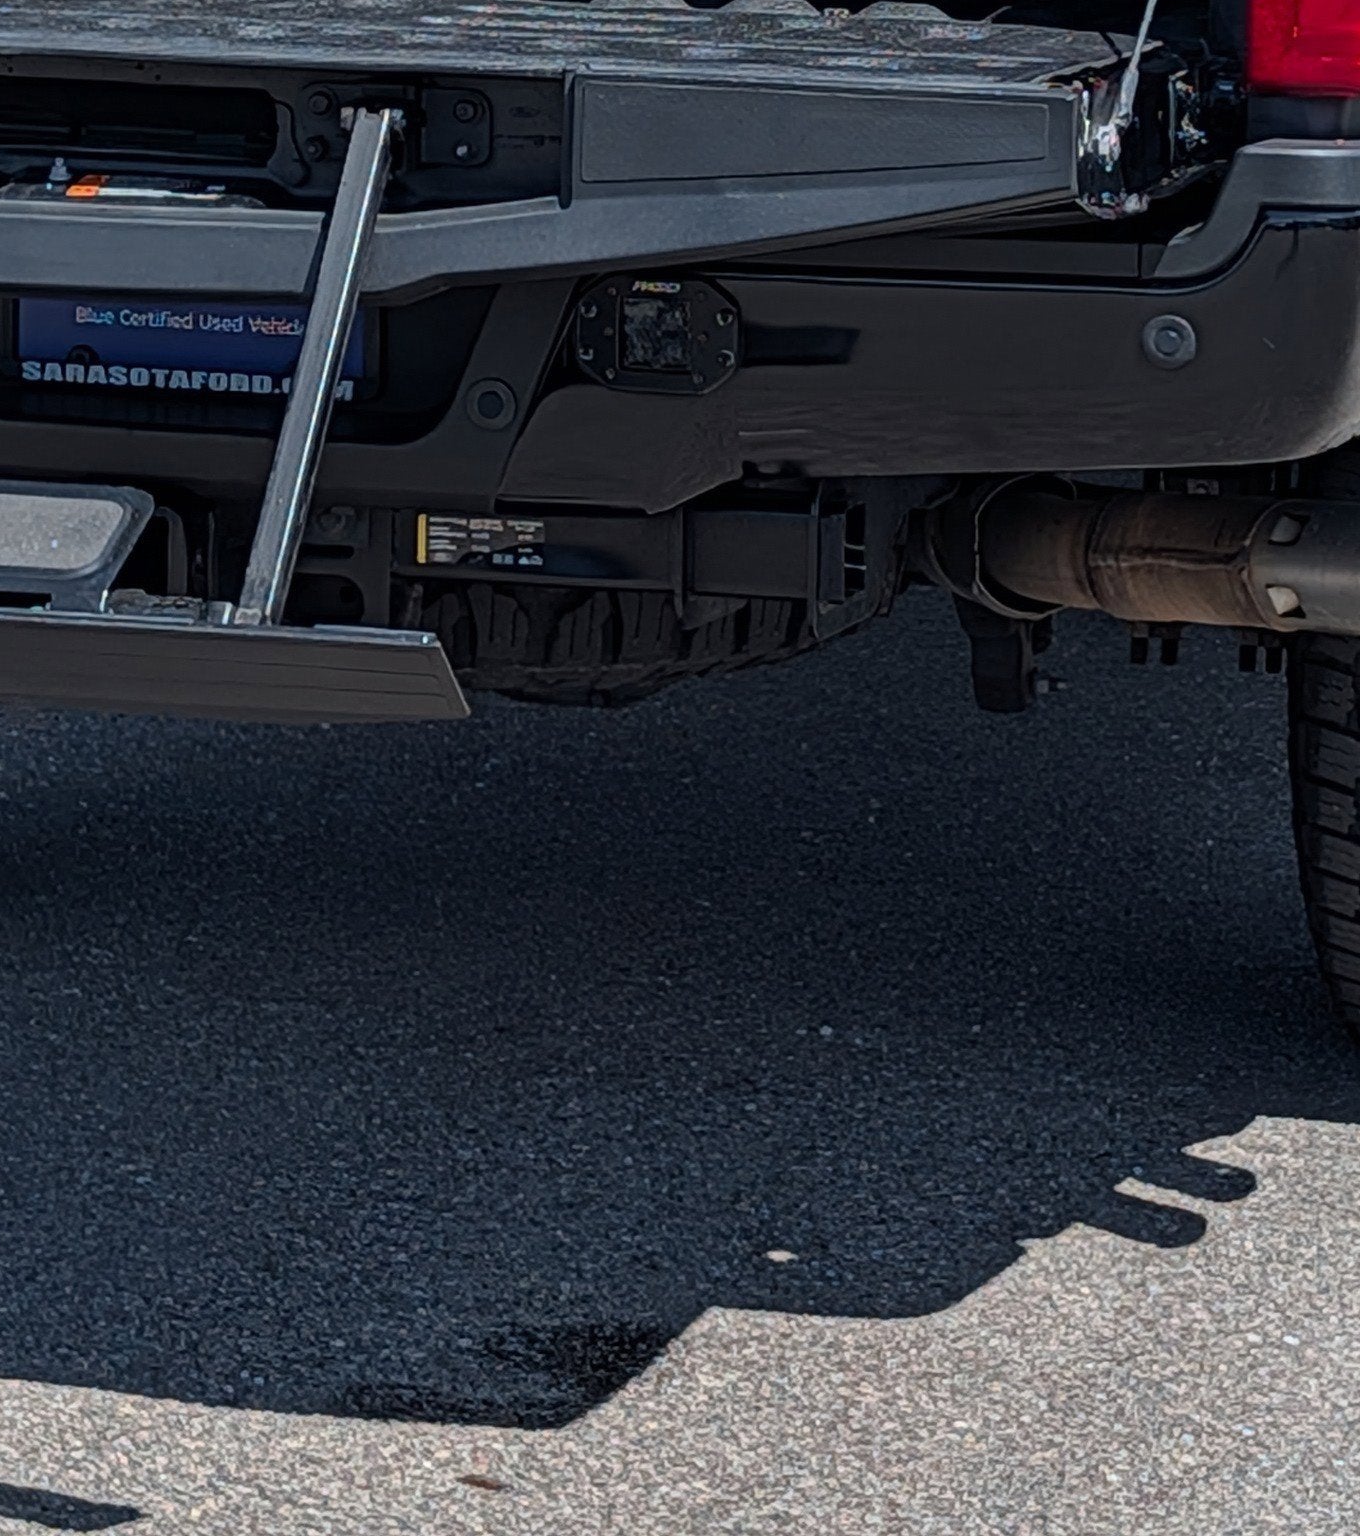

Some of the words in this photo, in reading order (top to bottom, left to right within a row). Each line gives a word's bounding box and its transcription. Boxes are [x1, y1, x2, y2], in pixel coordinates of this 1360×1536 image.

[75, 305, 116, 324] Blue
[119, 308, 194, 330] Certified
[199, 313, 244, 333] Used
